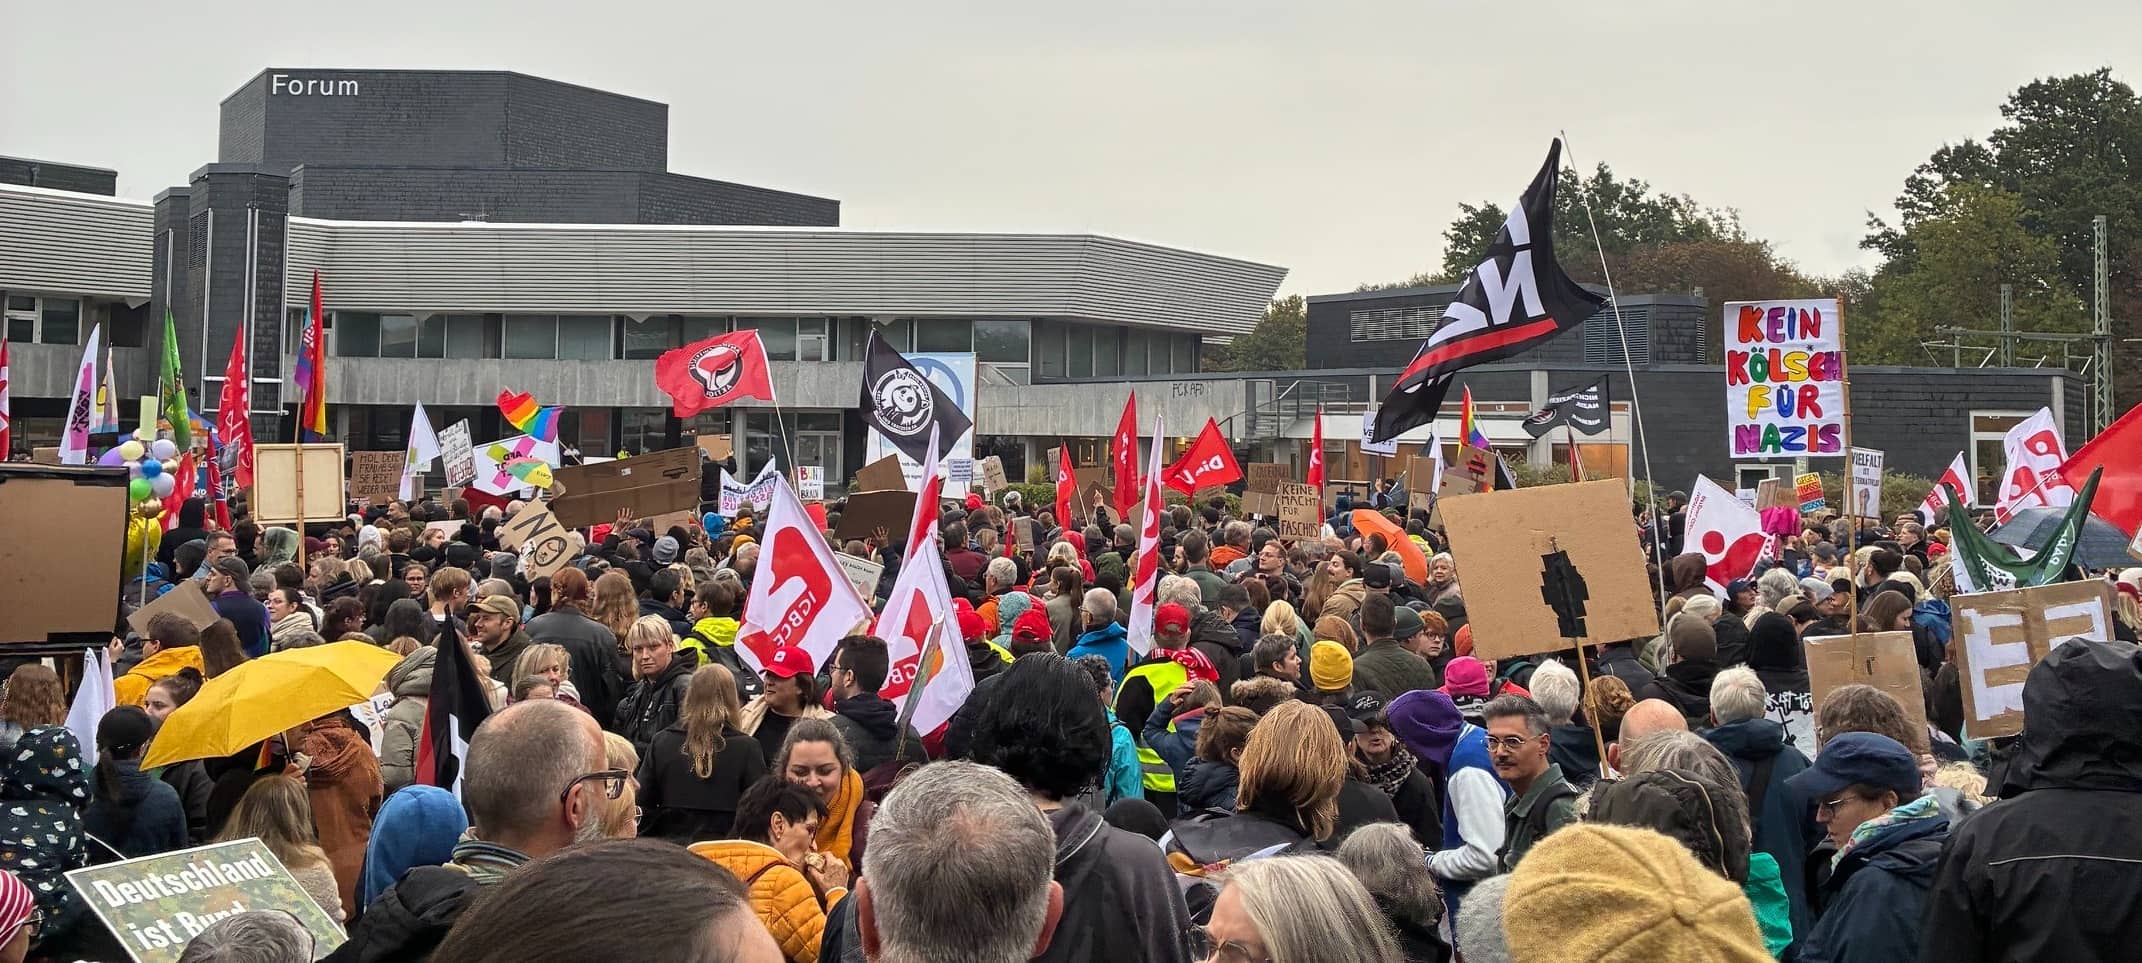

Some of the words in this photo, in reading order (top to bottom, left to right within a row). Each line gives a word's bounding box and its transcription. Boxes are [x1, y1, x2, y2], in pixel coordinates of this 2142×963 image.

[272, 74, 359, 96] Forum
[1738, 305, 1821, 344] KEIN
[1727, 346, 1843, 386] KÖLSCH
[1747, 384, 1823, 419] FÜR
[1735, 423, 1841, 454] NAZIS
[1852, 452, 1882, 468] VIELFALT
[1281, 496, 1317, 506] MACHT
[1281, 520, 1319, 538] FASCHOS
[92, 851, 274, 909] Deutschland
[128, 920, 184, 950] ist
